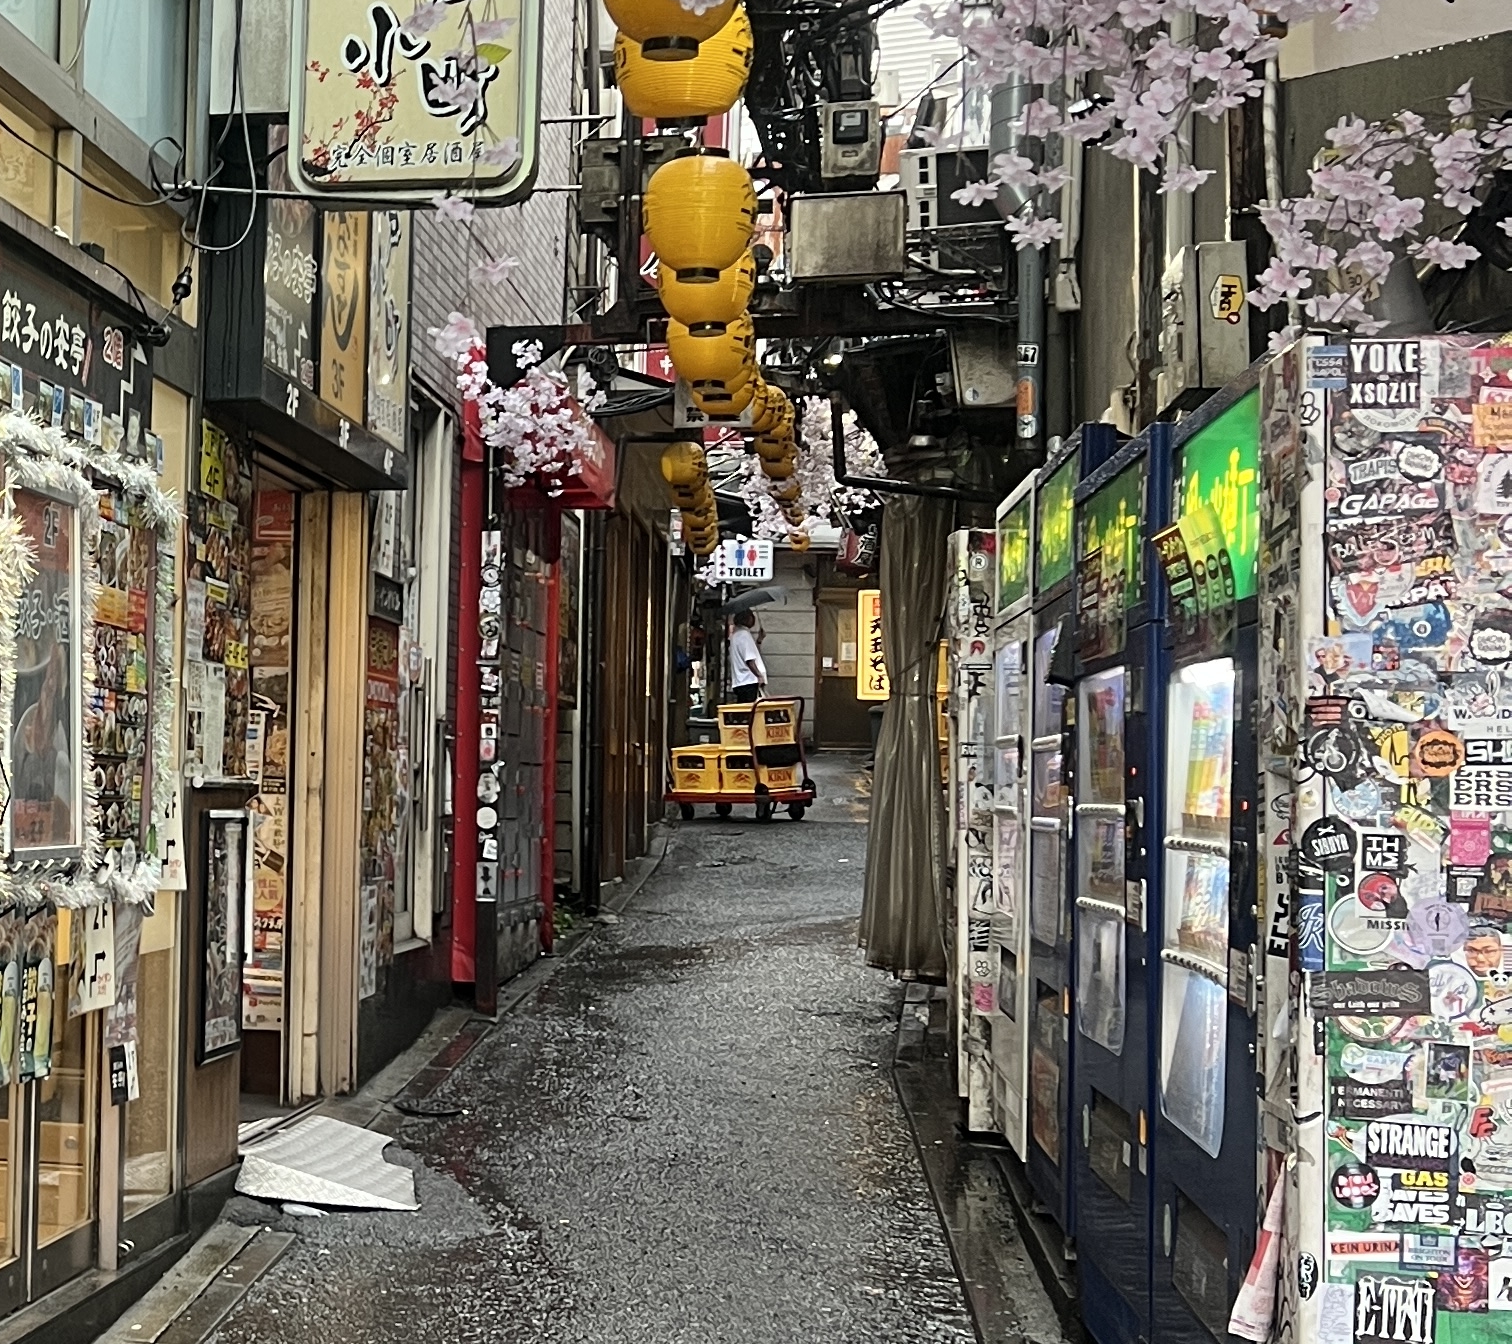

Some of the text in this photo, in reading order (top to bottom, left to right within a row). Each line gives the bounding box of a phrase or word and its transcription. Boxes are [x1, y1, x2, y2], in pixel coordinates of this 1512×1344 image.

[1350, 342, 1419, 374] YOKE
[727, 567, 767, 579] TOILET
[766, 727, 792, 740] KIRIN
[1367, 1121, 1451, 1160] STRANGE
[1400, 1170, 1450, 1188] GAS
